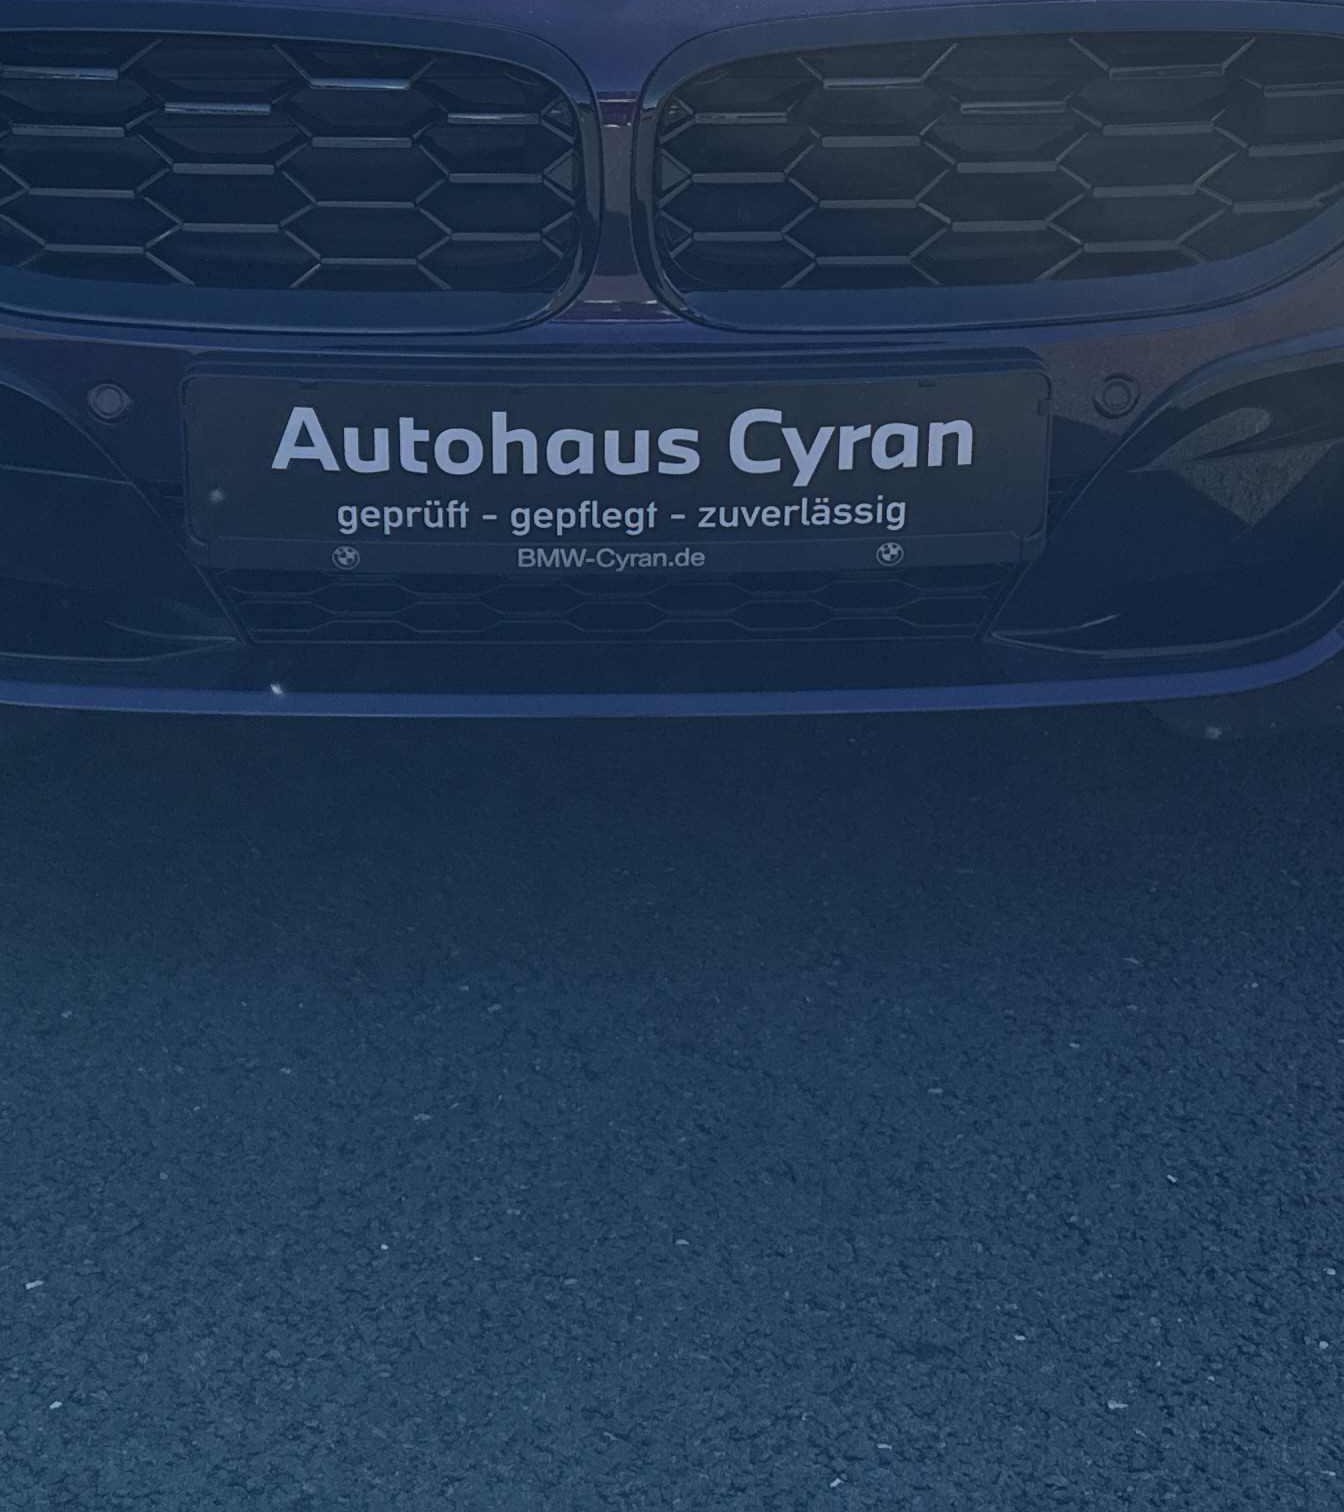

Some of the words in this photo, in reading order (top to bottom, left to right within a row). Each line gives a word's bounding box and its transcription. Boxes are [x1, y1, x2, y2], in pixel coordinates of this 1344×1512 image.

[270, 406, 701, 476] Autohaus
[728, 407, 974, 488] Cyran
[336, 499, 471, 536] geprüft
[509, 500, 659, 537] gepflegt
[697, 495, 907, 532] zuverlässig
[517, 547, 706, 572] BMW-Cyran.de
